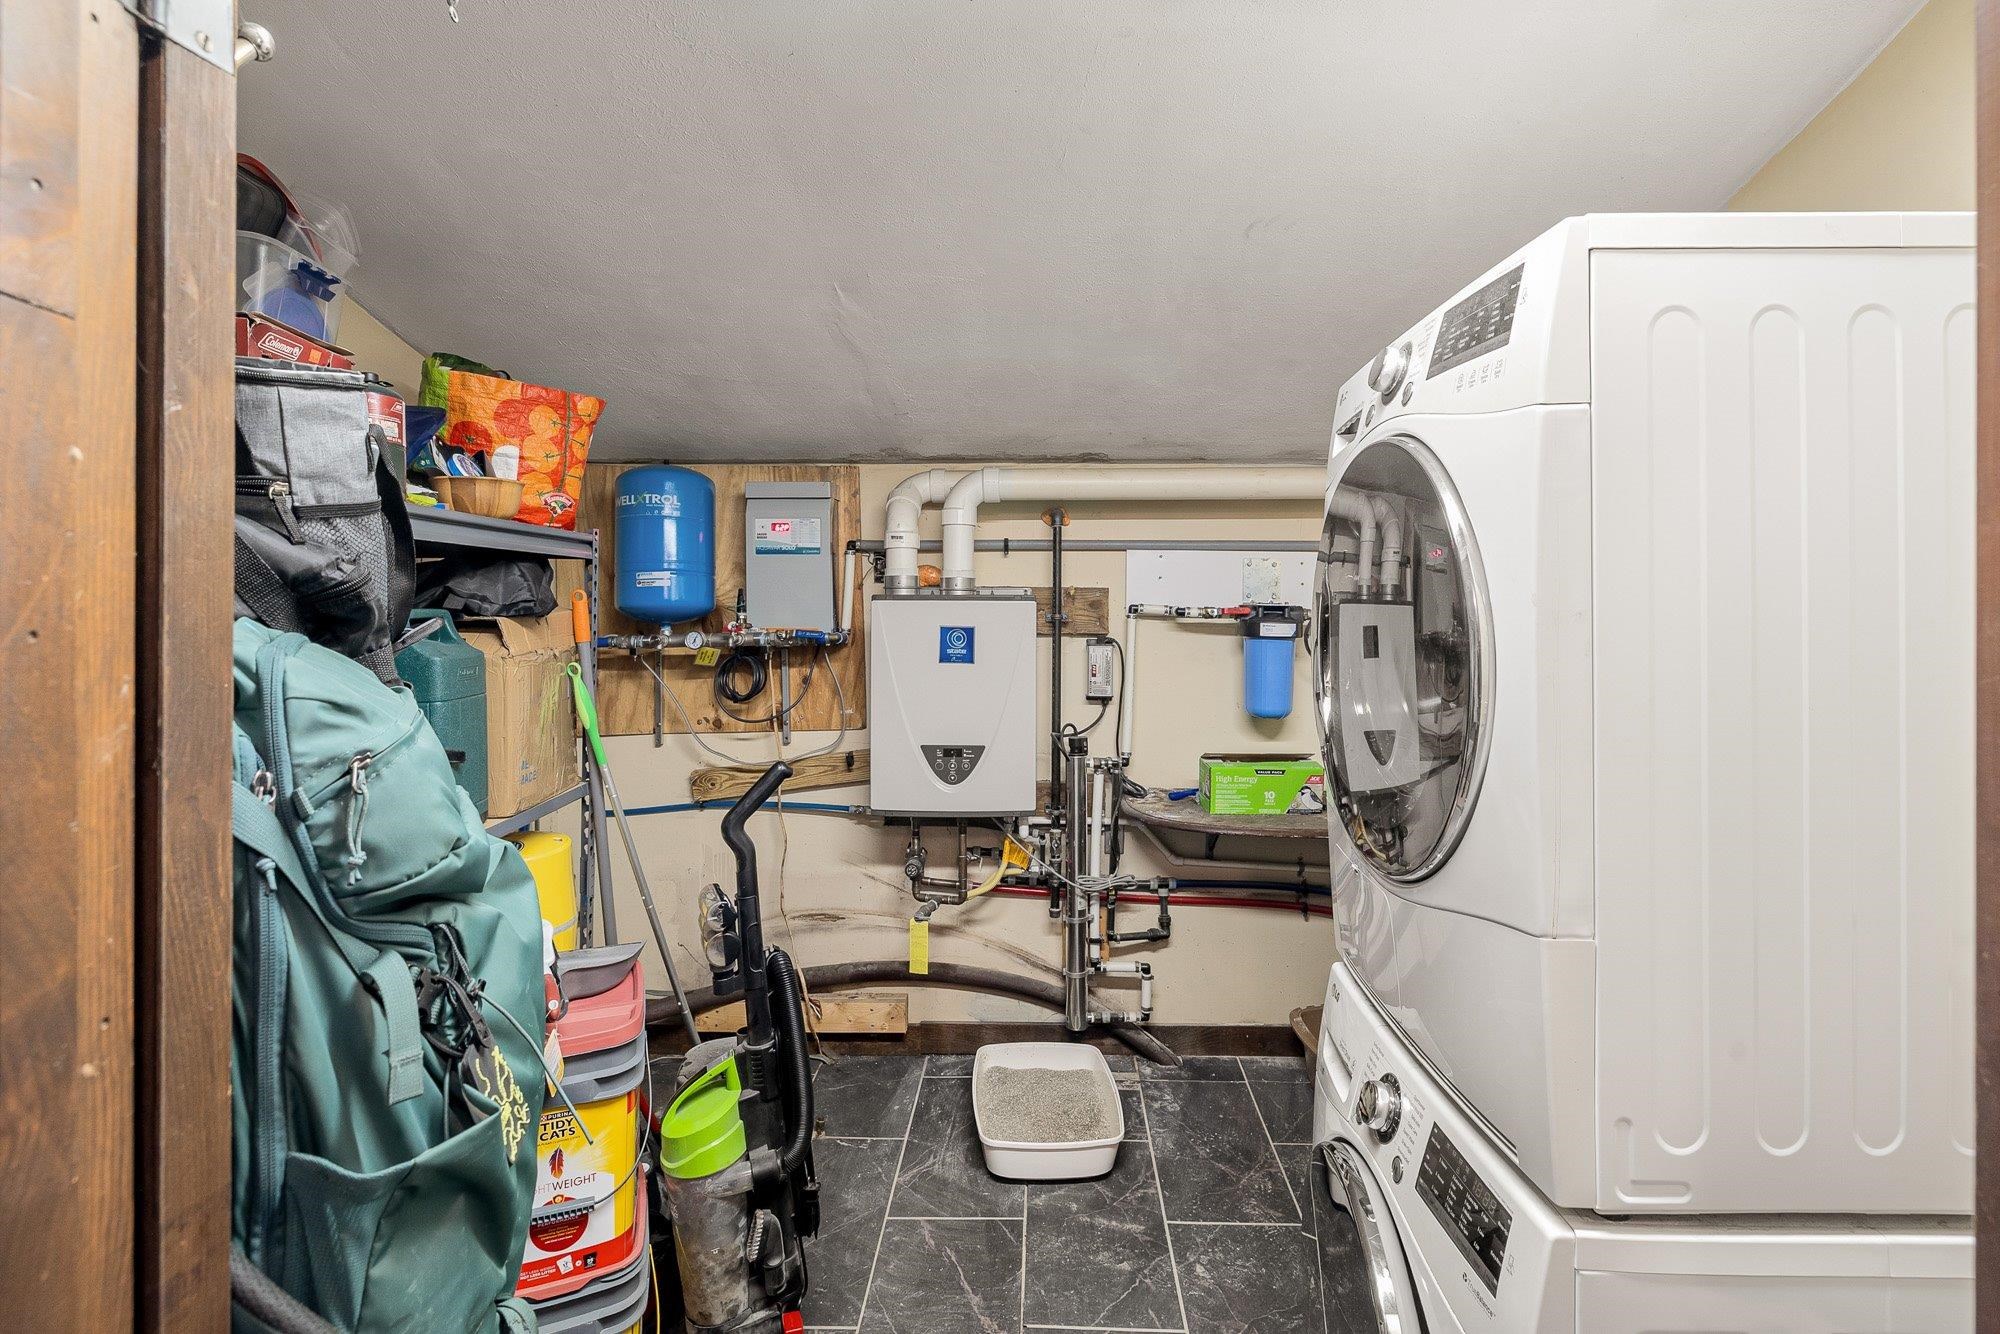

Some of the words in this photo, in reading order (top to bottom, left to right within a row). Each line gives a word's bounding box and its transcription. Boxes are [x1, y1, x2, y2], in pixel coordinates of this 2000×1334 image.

[265, 335, 293, 353] Coleman
[1216, 775, 1233, 784] High
[1235, 775, 1258, 785] Energy
[1264, 791, 1275, 799] 10
[540, 1118, 574, 1132] TIDY
[540, 1127, 576, 1142] CATS
